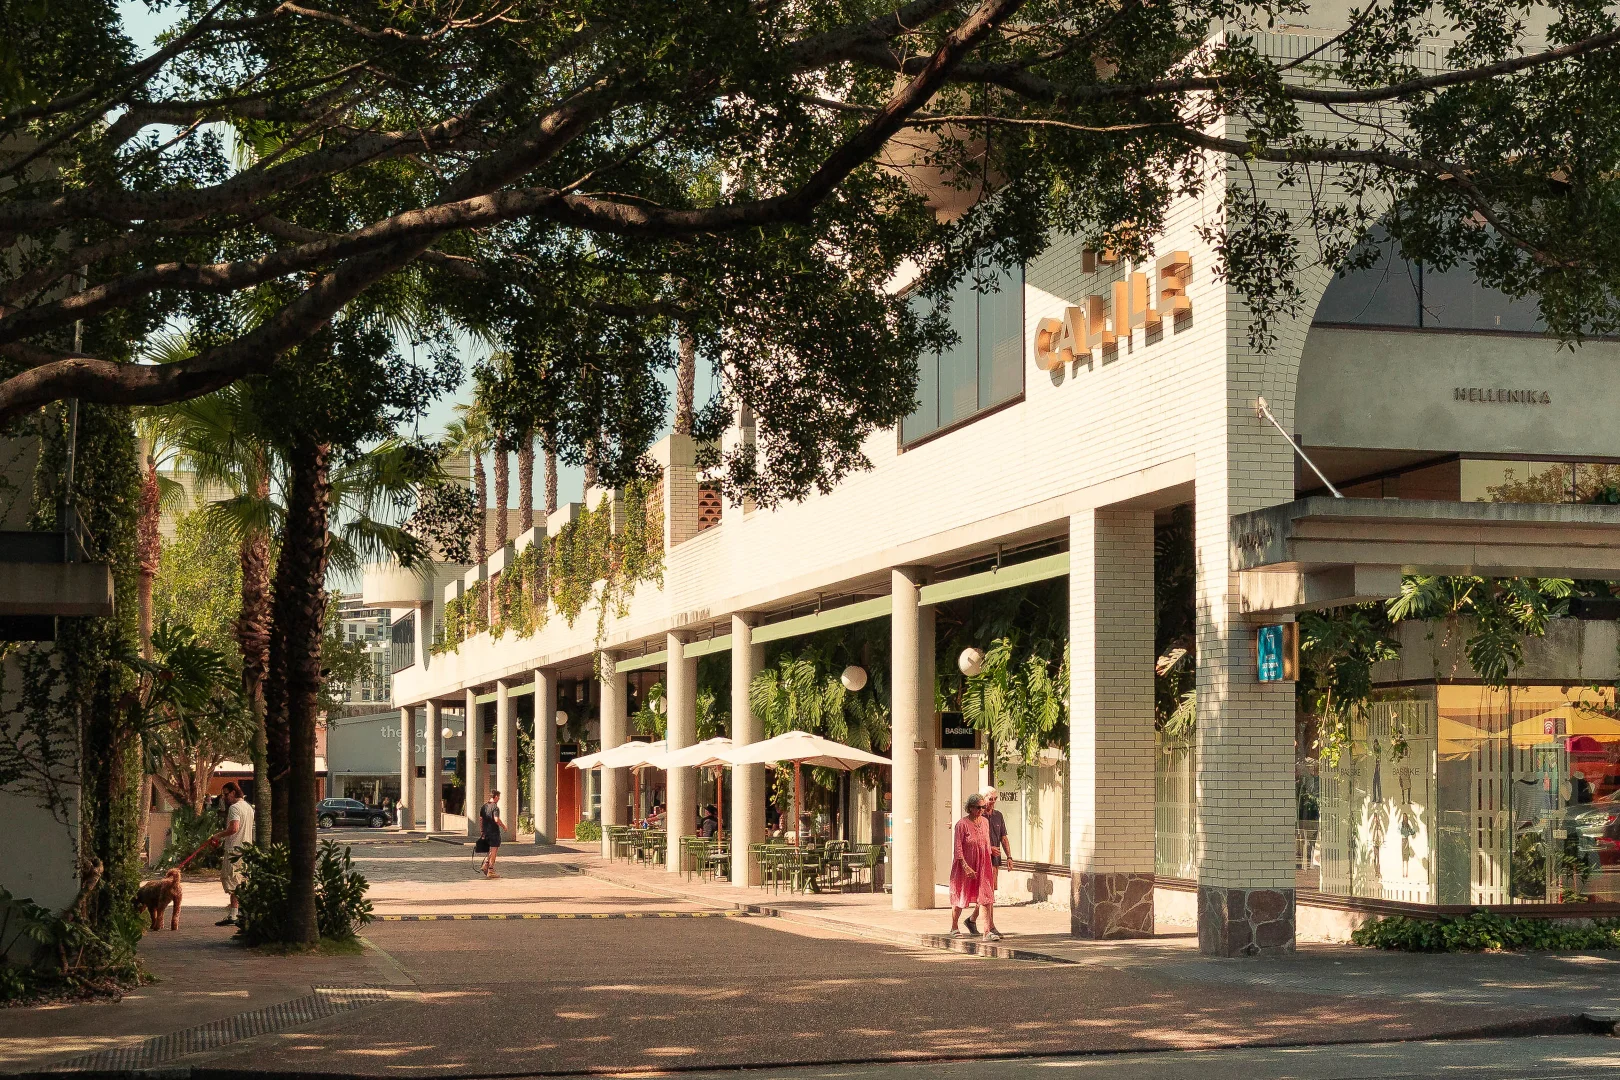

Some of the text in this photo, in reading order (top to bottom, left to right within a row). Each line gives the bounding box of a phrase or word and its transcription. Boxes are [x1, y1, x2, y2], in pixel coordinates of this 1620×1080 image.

[1034, 250, 1191, 372] CALILE
[1453, 387, 1551, 405] HELLENIKA
[945, 727, 973, 735] BASSIKE
[1392, 767, 1420, 776] BASSIKE
